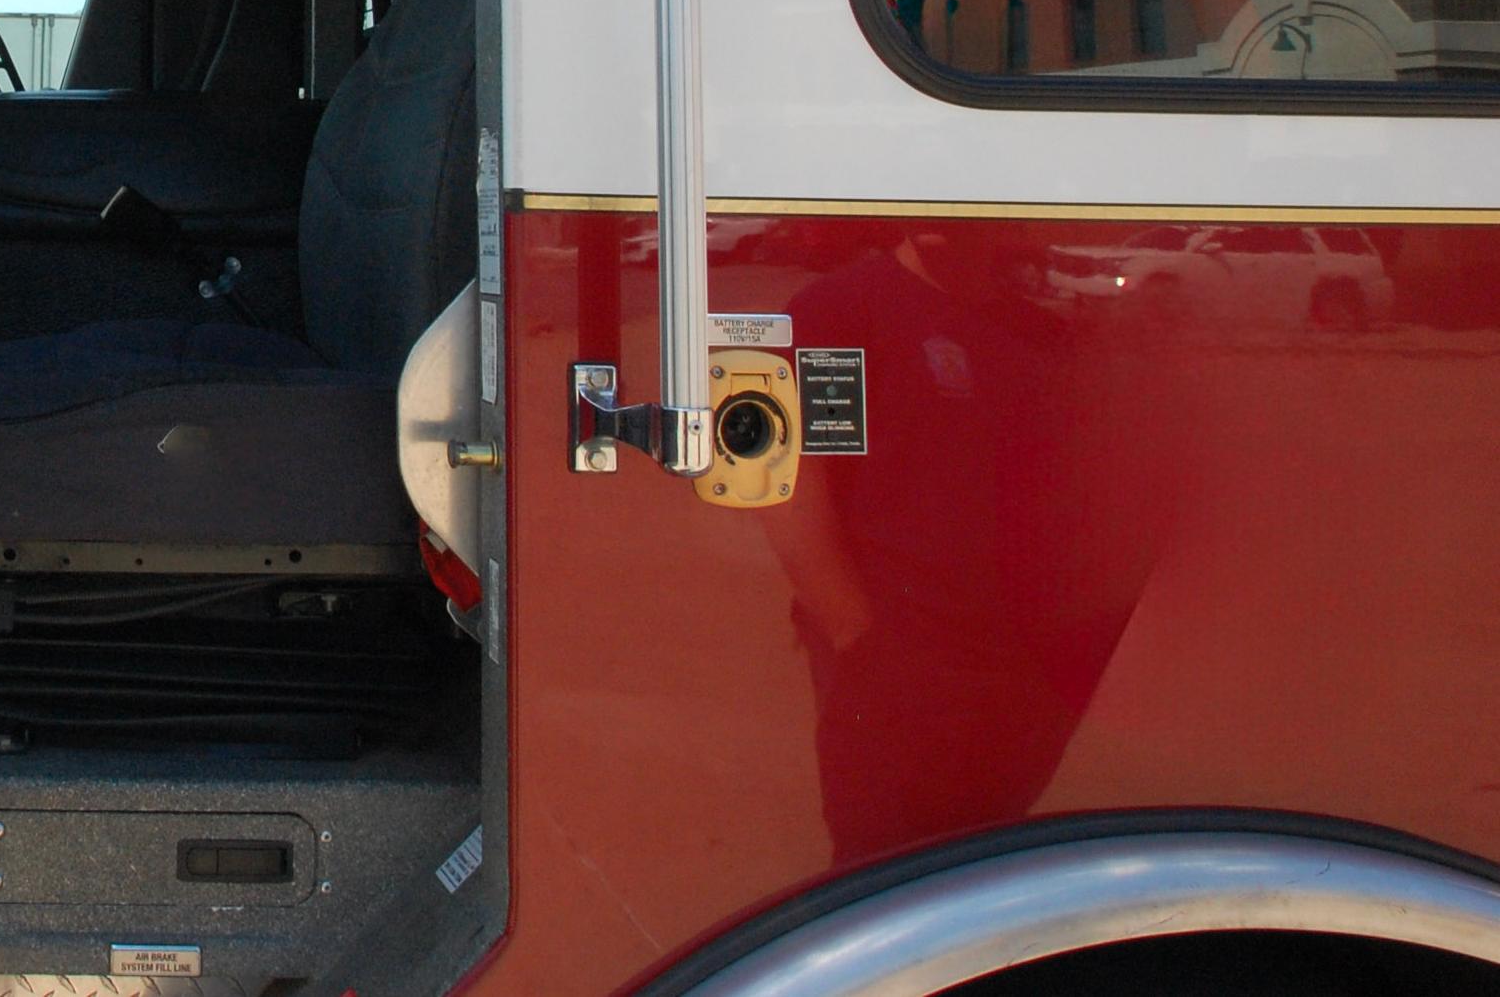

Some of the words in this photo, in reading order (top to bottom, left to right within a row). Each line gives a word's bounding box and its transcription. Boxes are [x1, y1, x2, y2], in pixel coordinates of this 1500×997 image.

[714, 319, 744, 327] BATTERY
[723, 327, 766, 335] RECEPTACLE
[135, 953, 149, 962] AIR
[151, 953, 178, 962] BRAKE
[120, 963, 154, 972] SYSTEM
[155, 963, 172, 972] FILL
[174, 963, 191, 972] LINE
